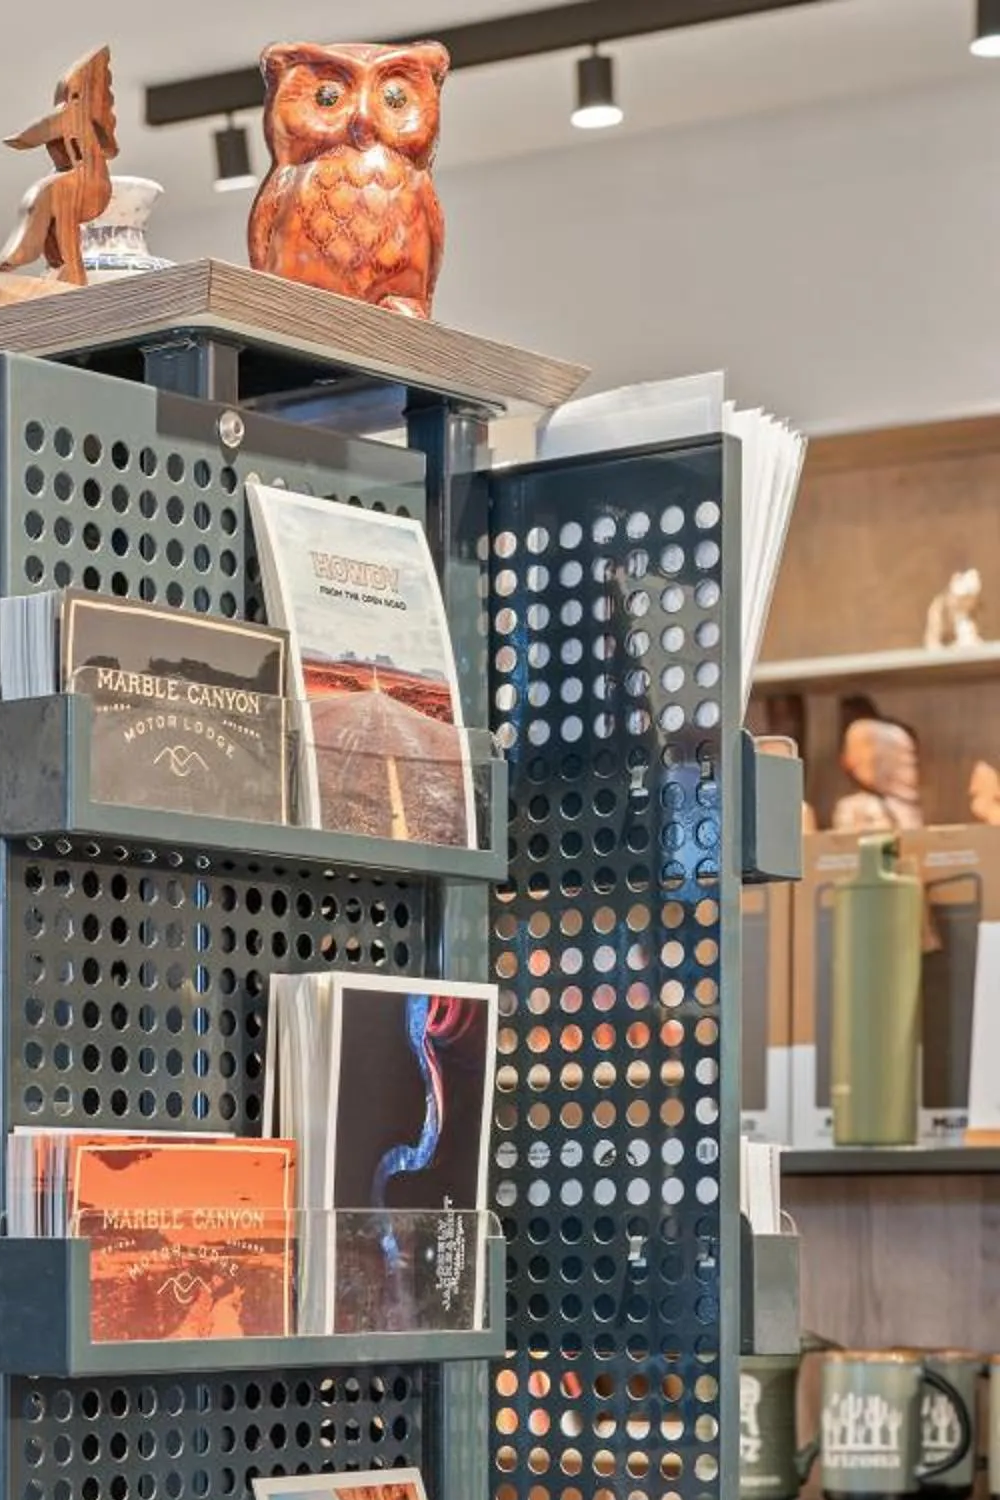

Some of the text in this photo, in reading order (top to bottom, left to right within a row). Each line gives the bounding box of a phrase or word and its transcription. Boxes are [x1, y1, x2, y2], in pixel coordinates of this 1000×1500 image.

[97, 667, 260, 714] MARBLE CANYON
[123, 715, 236, 759] MOTOR LODGE
[103, 1208, 264, 1230] MARBLE CANYON
